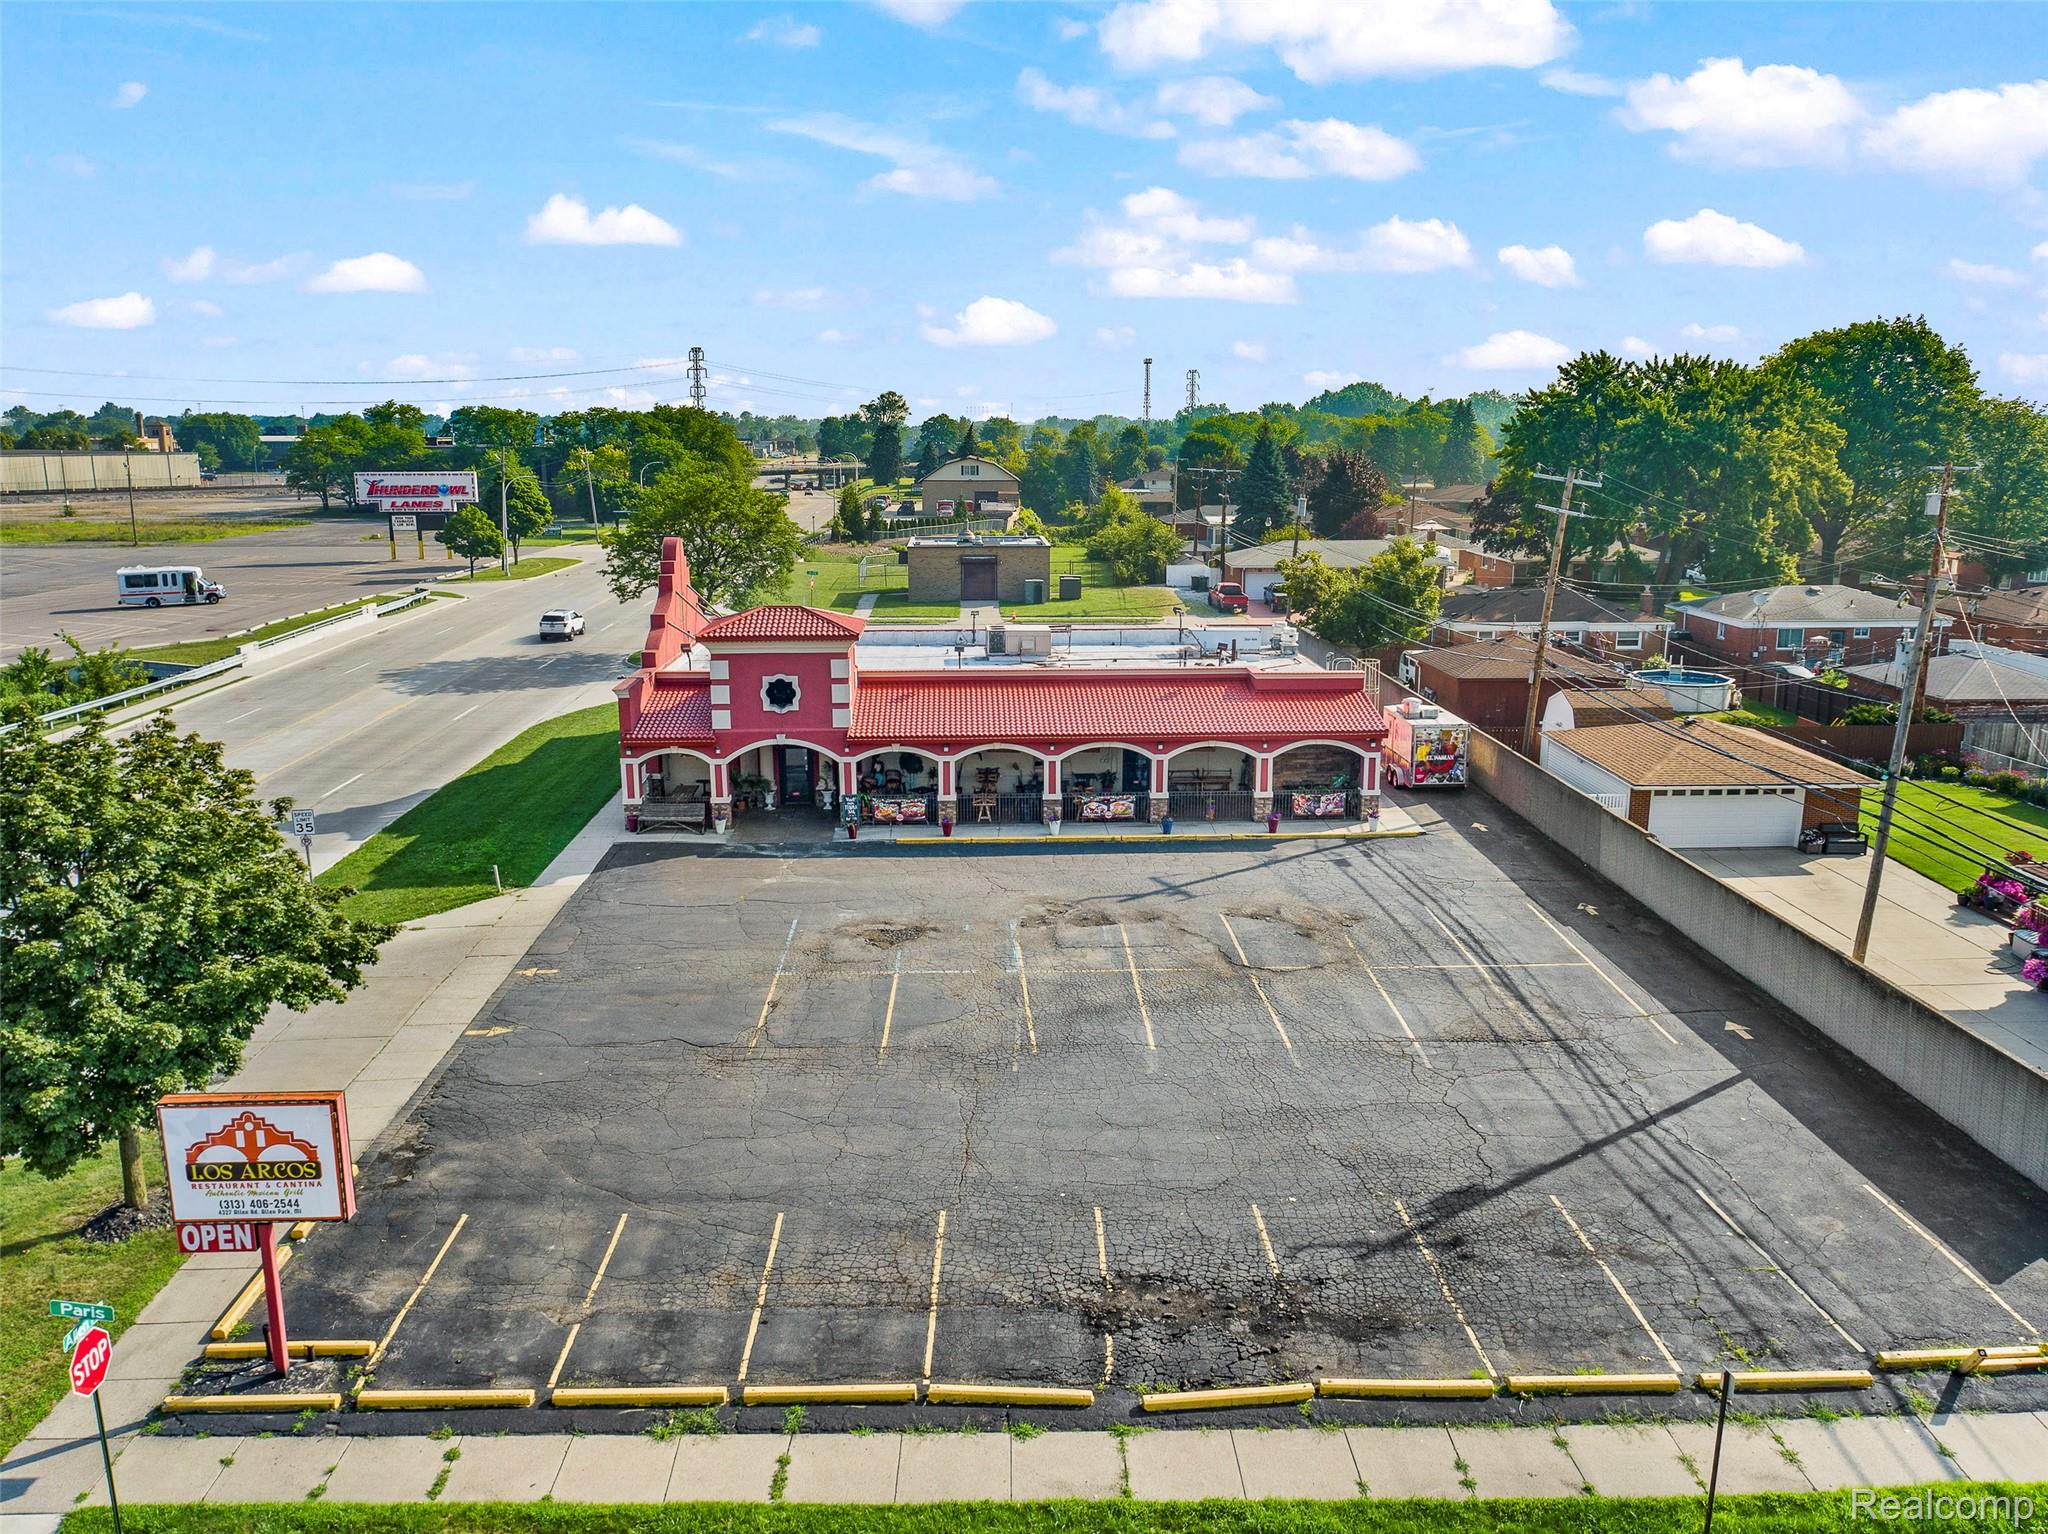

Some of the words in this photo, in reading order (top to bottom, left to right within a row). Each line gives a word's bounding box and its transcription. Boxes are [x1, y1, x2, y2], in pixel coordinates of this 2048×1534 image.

[390, 500, 444, 508] LANES
[296, 822, 314, 833] 35
[191, 1164, 233, 1180] LOS
[241, 1162, 316, 1179] ARCOS
[191, 1182, 259, 1190] RESTAURANT
[283, 1189, 304, 1197] Grill
[219, 1199, 245, 1210] (313)
[250, 1198, 300, 1209] 406-2544
[181, 1224, 253, 1251] OPEN
[60, 1302, 105, 1319] Paris
[73, 1338, 107, 1386] STOP
